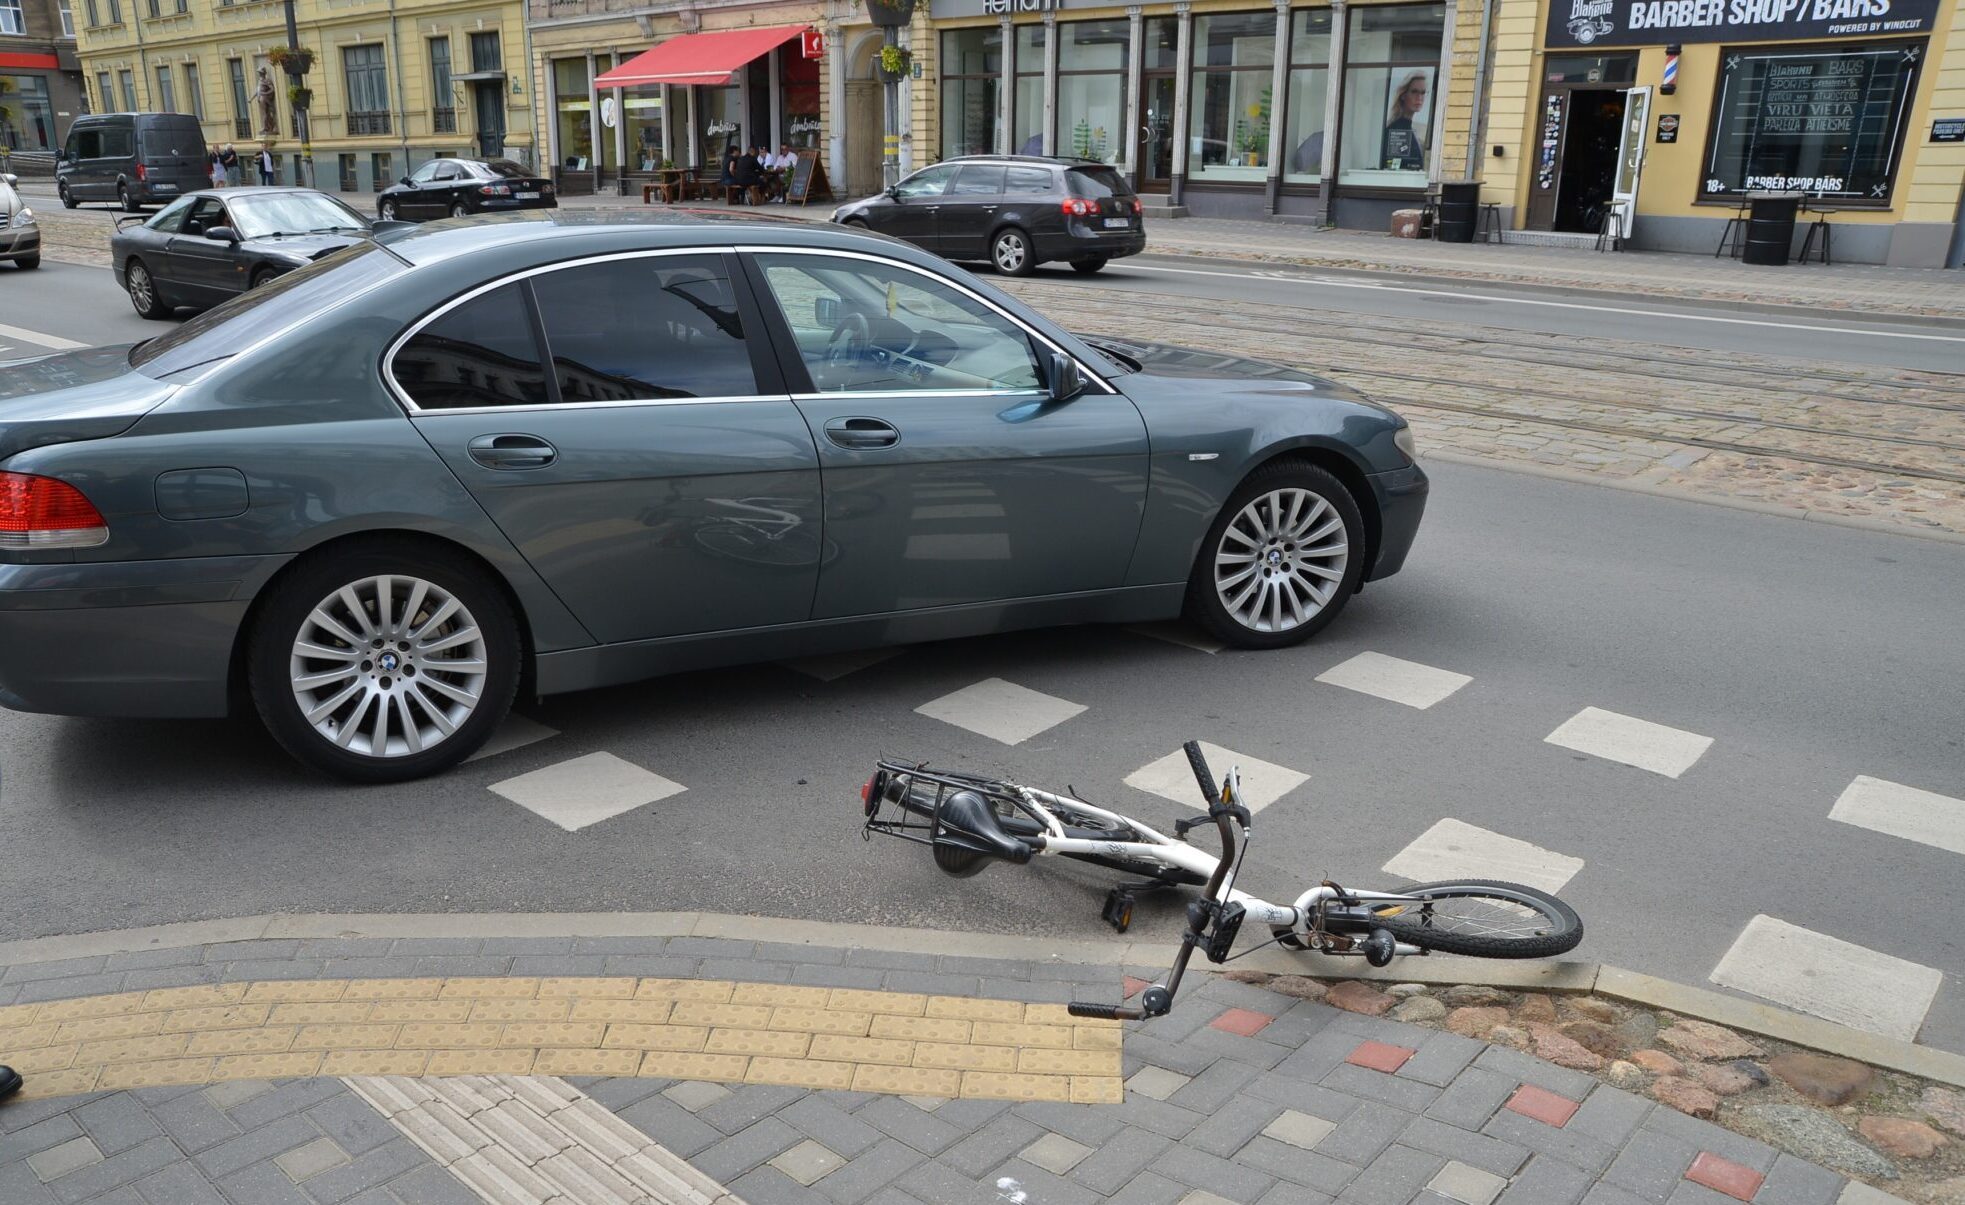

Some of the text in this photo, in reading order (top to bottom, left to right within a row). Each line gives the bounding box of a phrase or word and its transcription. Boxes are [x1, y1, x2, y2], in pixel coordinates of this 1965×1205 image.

[1629, 0, 1725, 29] BARBER
[1828, 24, 1868, 34] POWERED
[1869, 22, 1881, 32] BY
[1707, 180, 1725, 192] 18+
[1786, 177, 1813, 190] SHOP
